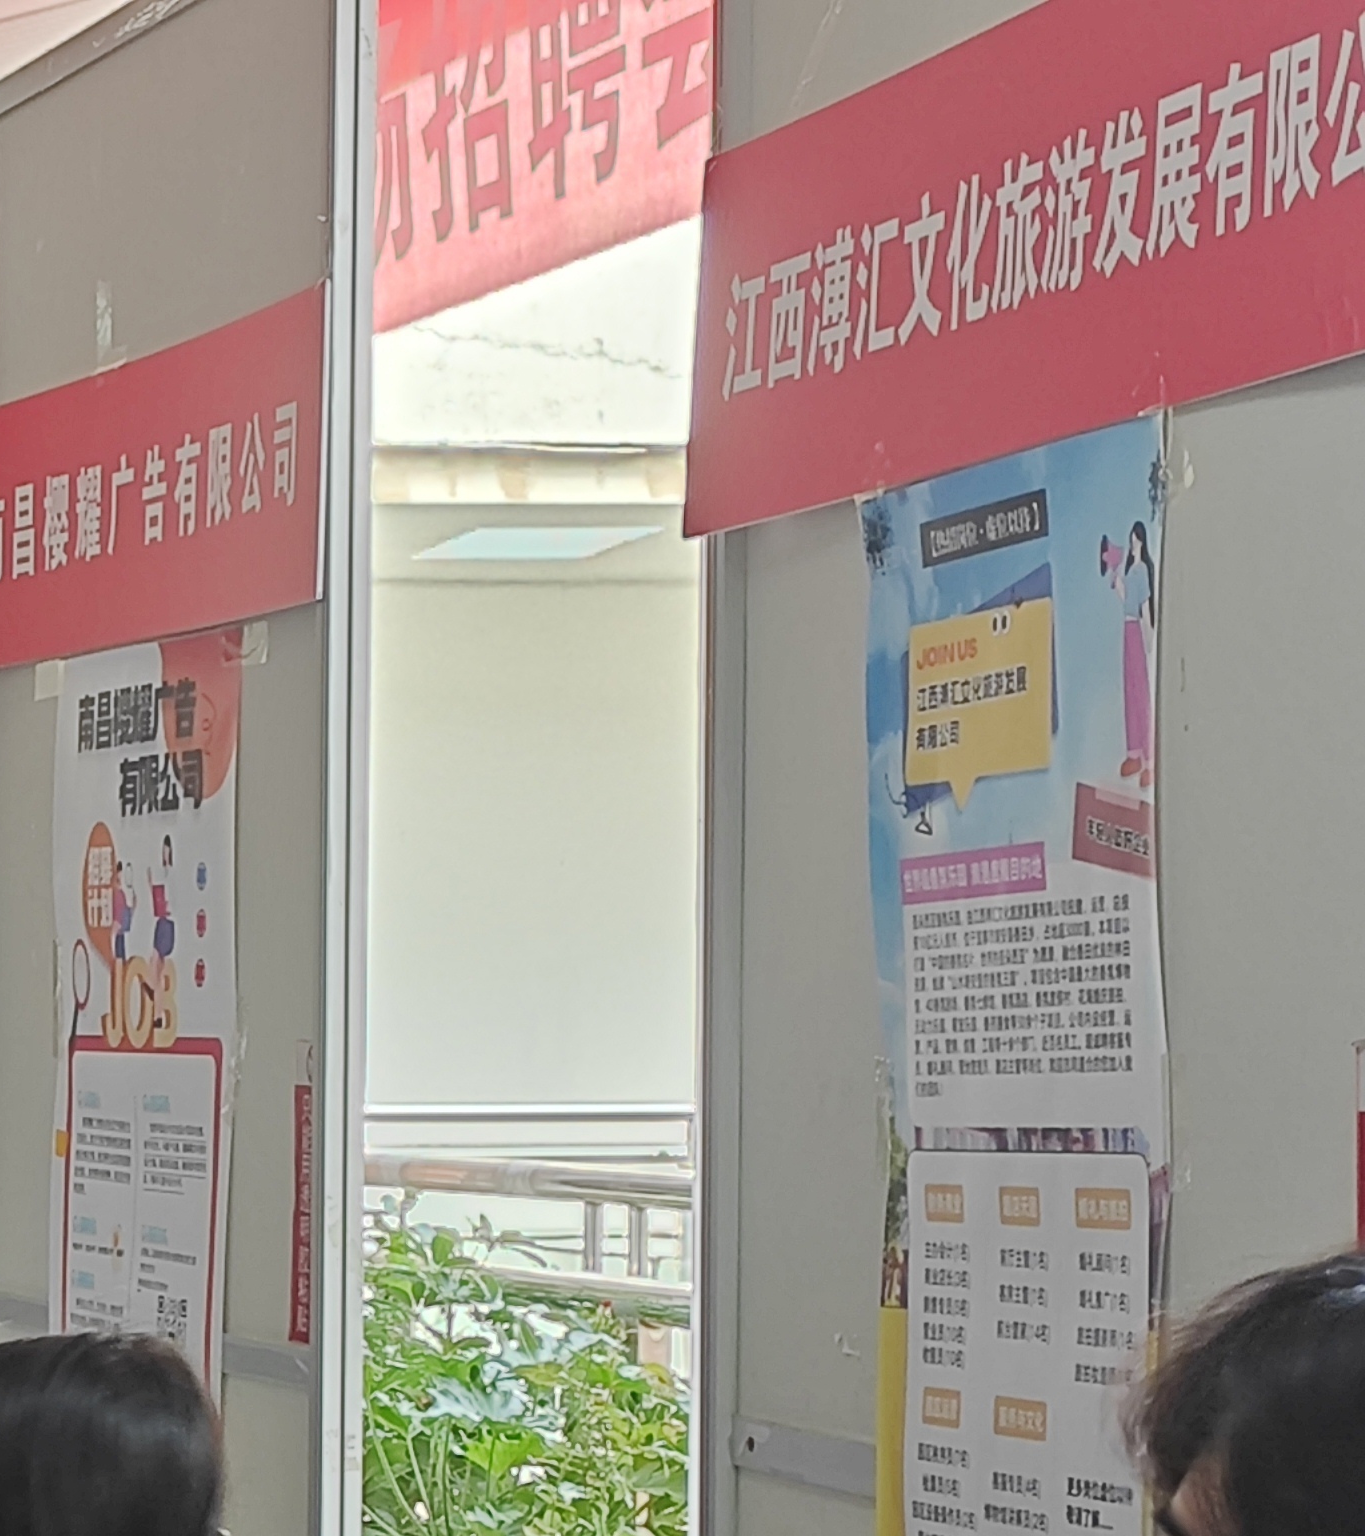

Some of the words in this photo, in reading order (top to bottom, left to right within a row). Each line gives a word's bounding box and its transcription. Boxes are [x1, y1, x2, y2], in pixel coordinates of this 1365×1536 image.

[916, 643, 955, 670] JOIN
[957, 638, 978, 661] US
[915, 721, 960, 750] 有限公司
[119, 748, 203, 818] 有限公司
